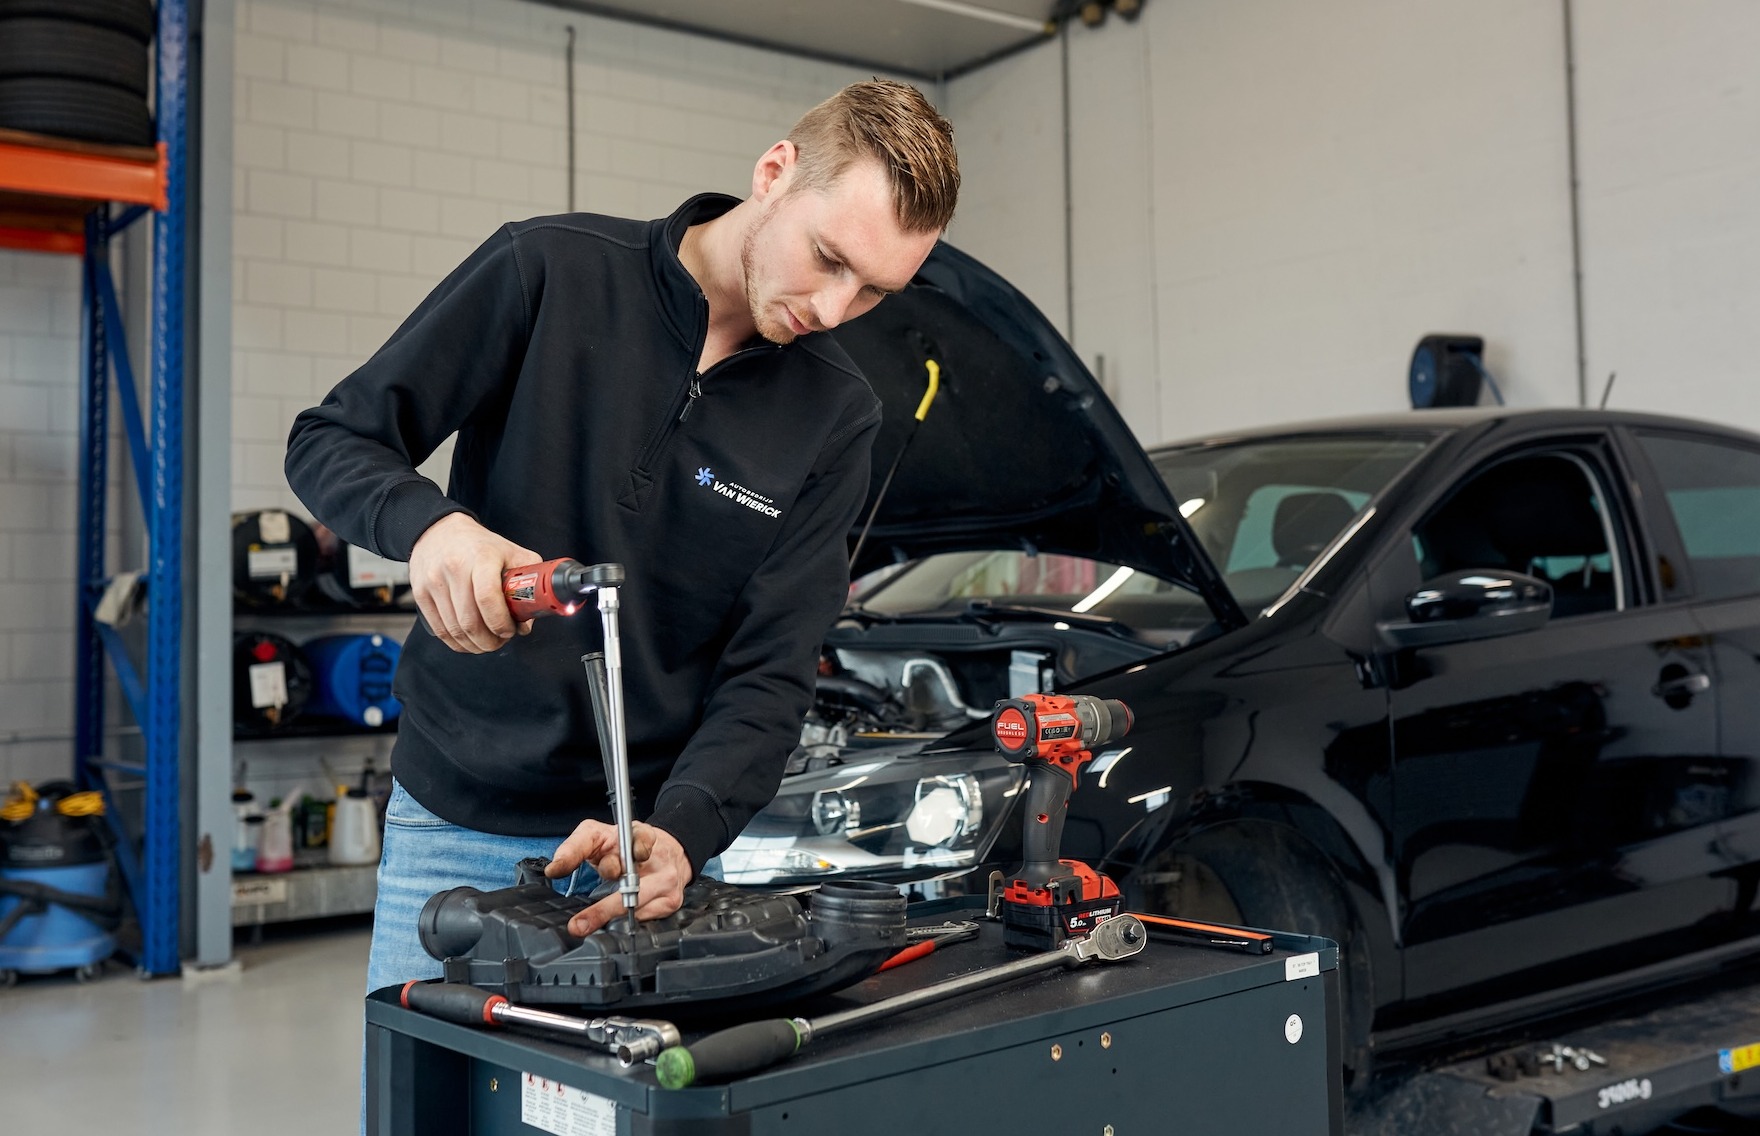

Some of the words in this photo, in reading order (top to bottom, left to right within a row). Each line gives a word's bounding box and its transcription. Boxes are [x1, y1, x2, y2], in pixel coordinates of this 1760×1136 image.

[713, 481, 736, 499] VAN
[736, 493, 782, 518] WIERICK
[729, 482, 774, 503] AUTOBEDRIJF
[997, 722, 1024, 731] FUEL
